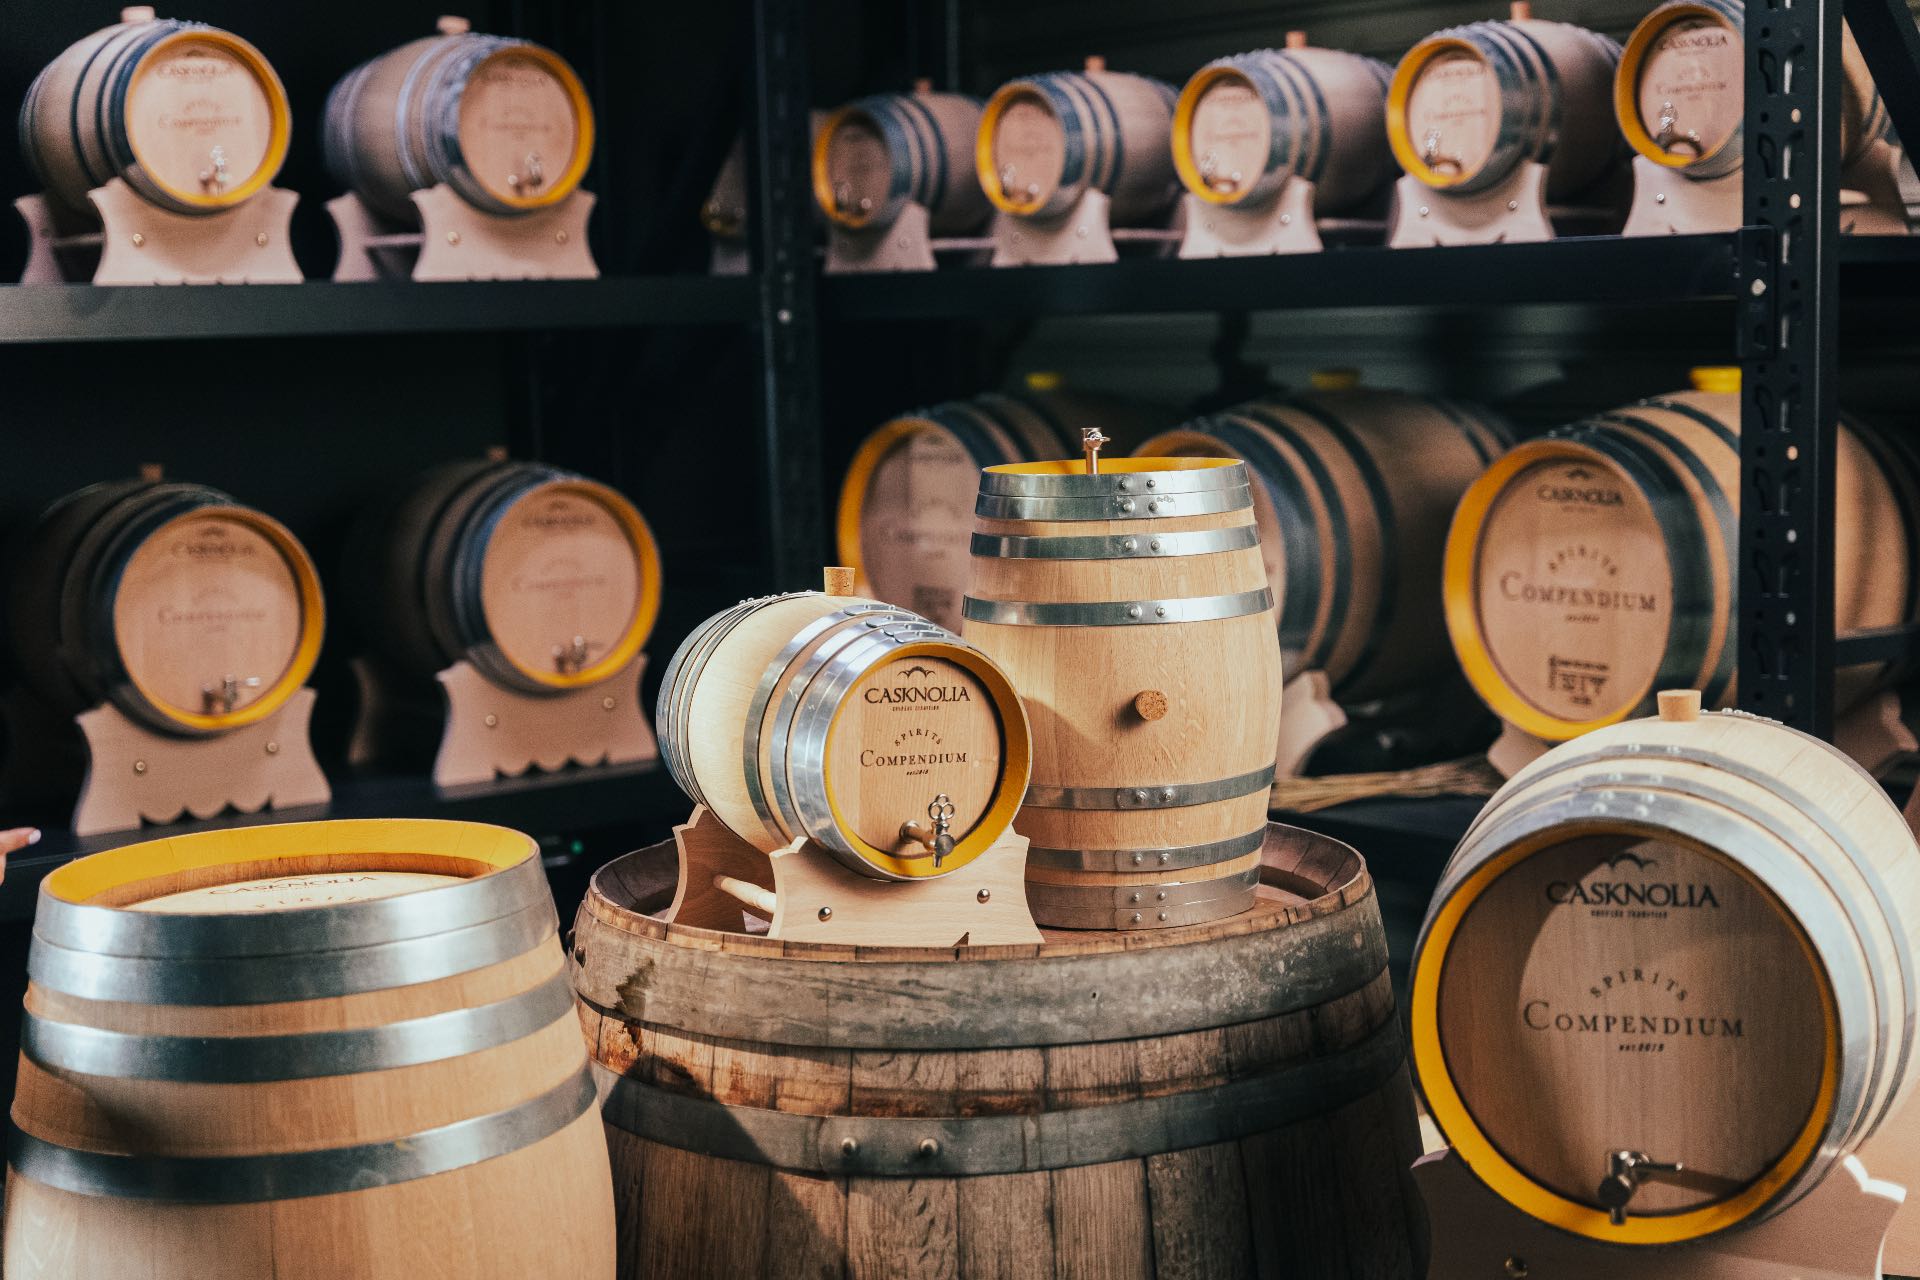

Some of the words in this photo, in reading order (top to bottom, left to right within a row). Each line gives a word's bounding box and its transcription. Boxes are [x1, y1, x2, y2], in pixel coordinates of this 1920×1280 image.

[864, 686, 971, 704] CASKNOLIA
[894, 728, 943, 747] SPIRITS
[860, 750, 967, 767] COMPENDIUM
[1545, 881, 1720, 908] CASKNOLIA
[1590, 967, 1689, 1002] SPIRITS
[1522, 1000, 1745, 1038] COMPENDIUM
